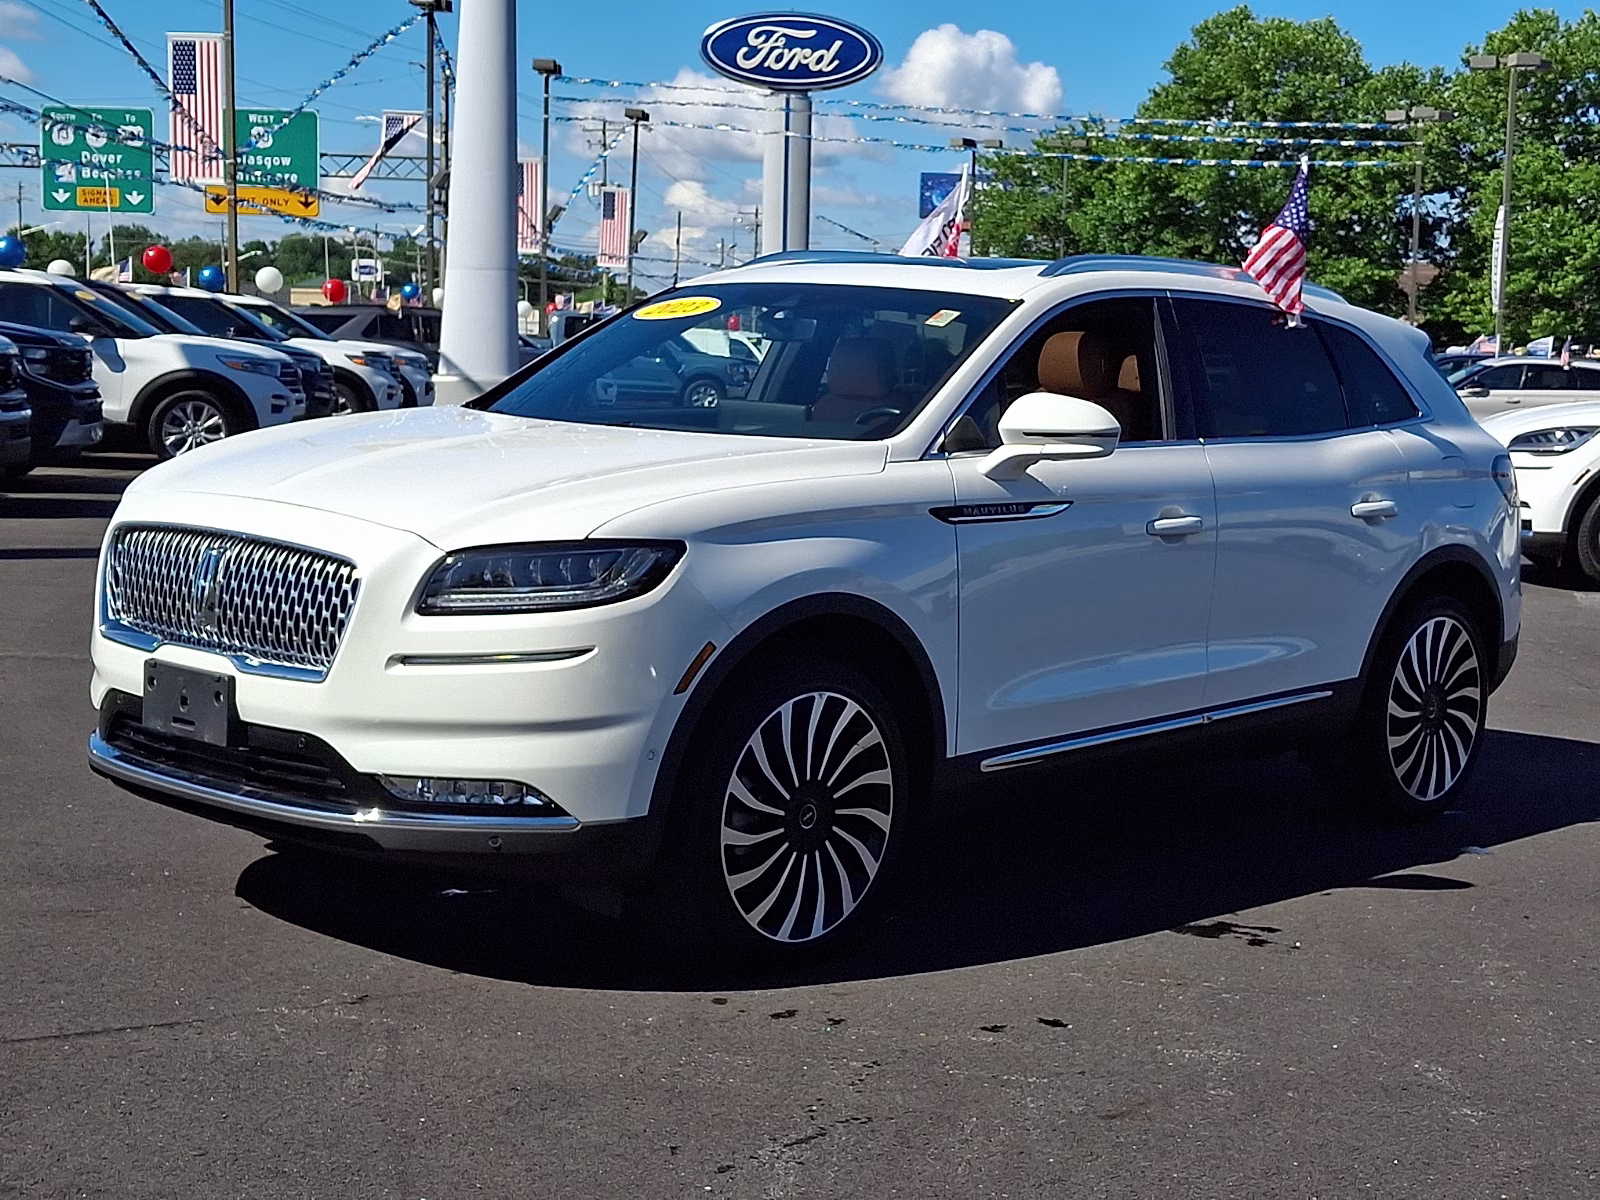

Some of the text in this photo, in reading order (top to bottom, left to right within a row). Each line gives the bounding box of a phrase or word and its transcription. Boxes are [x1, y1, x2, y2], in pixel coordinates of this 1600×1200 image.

[736, 26, 843, 72] Ford
[248, 113, 275, 123] WEST
[81, 151, 122, 164] Dover
[262, 197, 290, 206] ONLY
[963, 505, 1025, 516] NAUTILUS
